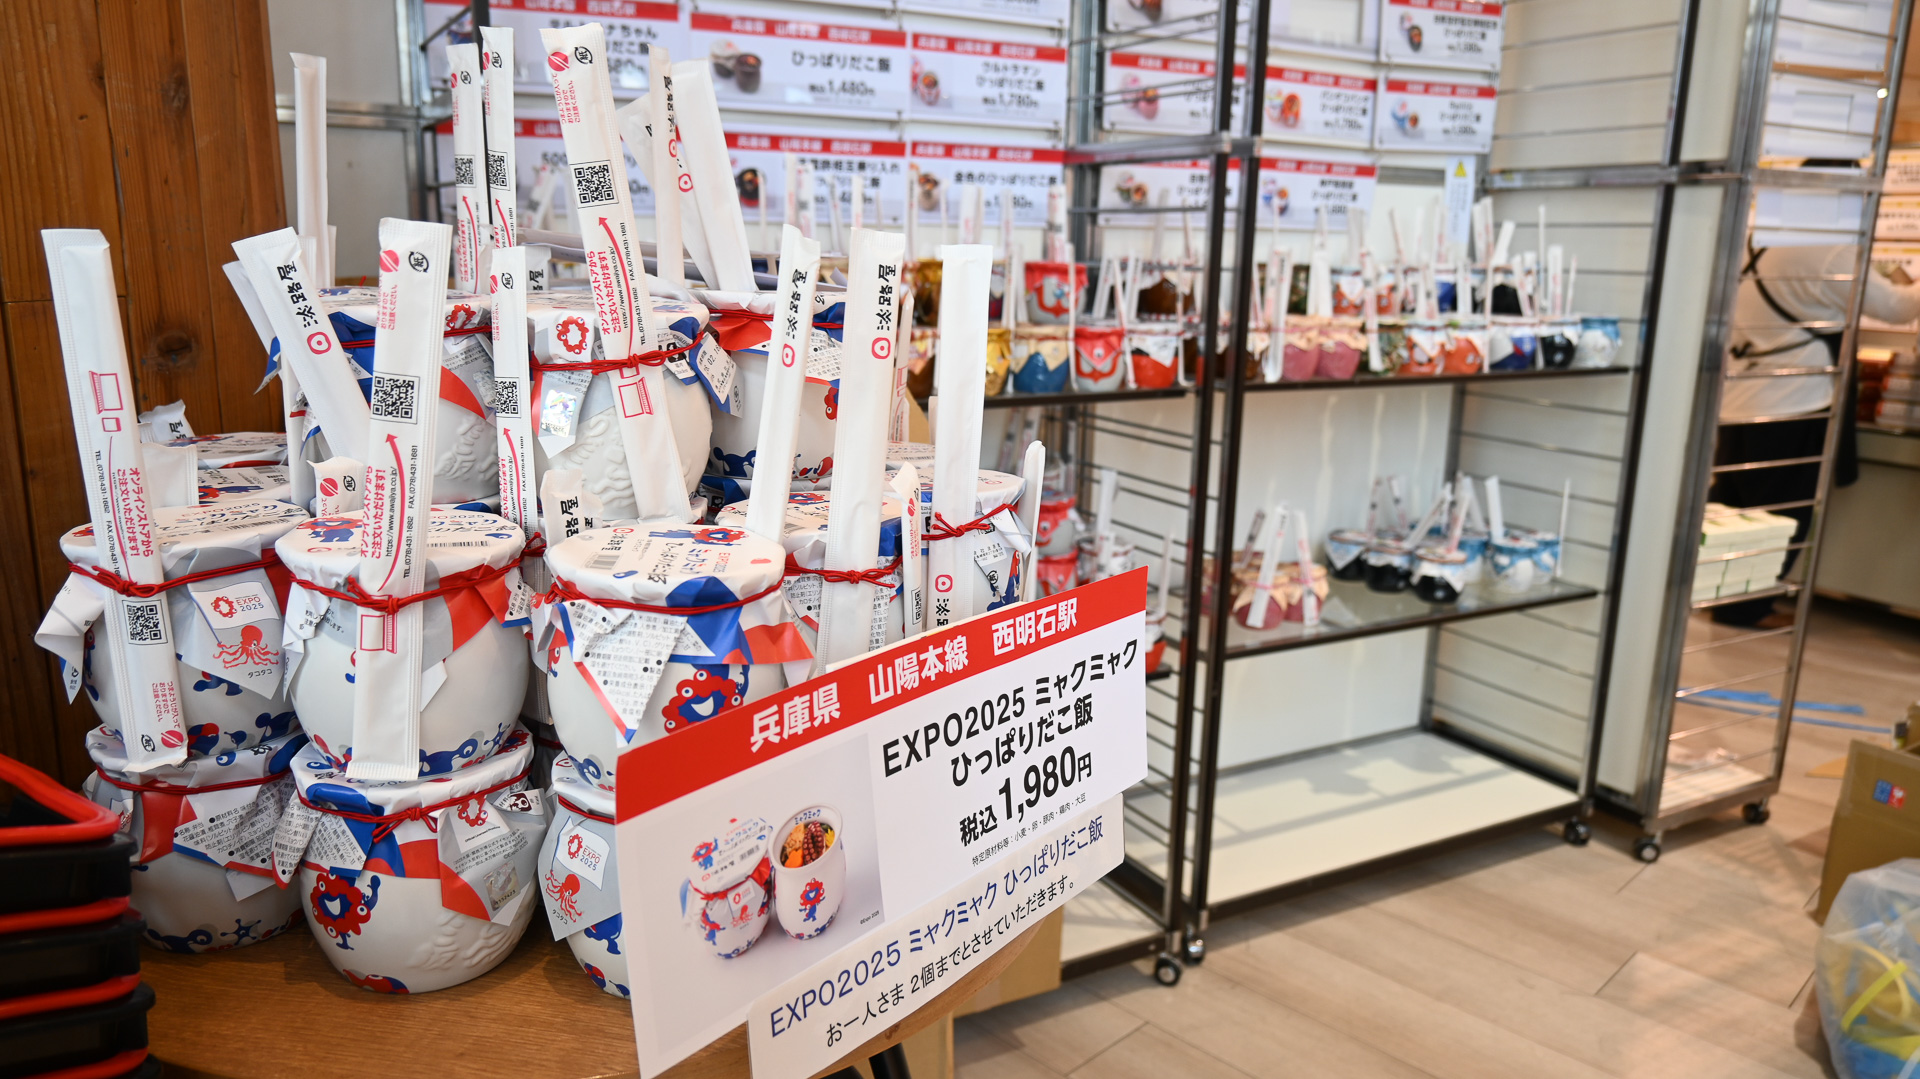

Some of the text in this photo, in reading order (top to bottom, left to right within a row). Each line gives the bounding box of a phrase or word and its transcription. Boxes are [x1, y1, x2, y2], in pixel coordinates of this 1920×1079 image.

[791, 51, 892, 73] ひっぱりだこ飯
[276, 259, 319, 329] 淡路屋
[586, 250, 611, 336] オンラインストアから
[786, 268, 808, 340] 淡路屋
[875, 264, 897, 331] 淡路屋
[94, 450, 111, 514] TEL.(078)431-1682
[129, 467, 154, 558] オンラインストアから
[385, 466, 398, 557] https://www.awajiya.co.jp/
[403, 445, 419, 579] TEL.(078)431-1682 FAX.(078)431-1681
[236, 596, 261, 606] EXPO
[240, 603, 265, 612] 2025
[158, 681, 170, 715] おりますので
[166, 680, 181, 730] つまようじが入って
[750, 597, 1078, 753] 兵庫県 山陽本線 西明石駅
[882, 639, 1138, 778] EXPO2025 ミャクミャク
[950, 693, 1093, 787] ひっぱりだこ飯
[959, 745, 1092, 847] 税込 1,980円
[579, 854, 598, 872] 2025
[582, 847, 601, 864] EXPO
[770, 815, 1104, 1038] EXPO2025 ミャクミャク ひっぱりだこ飯
[826, 875, 1076, 1048] お一人さま 2個までとさせていただきます。
